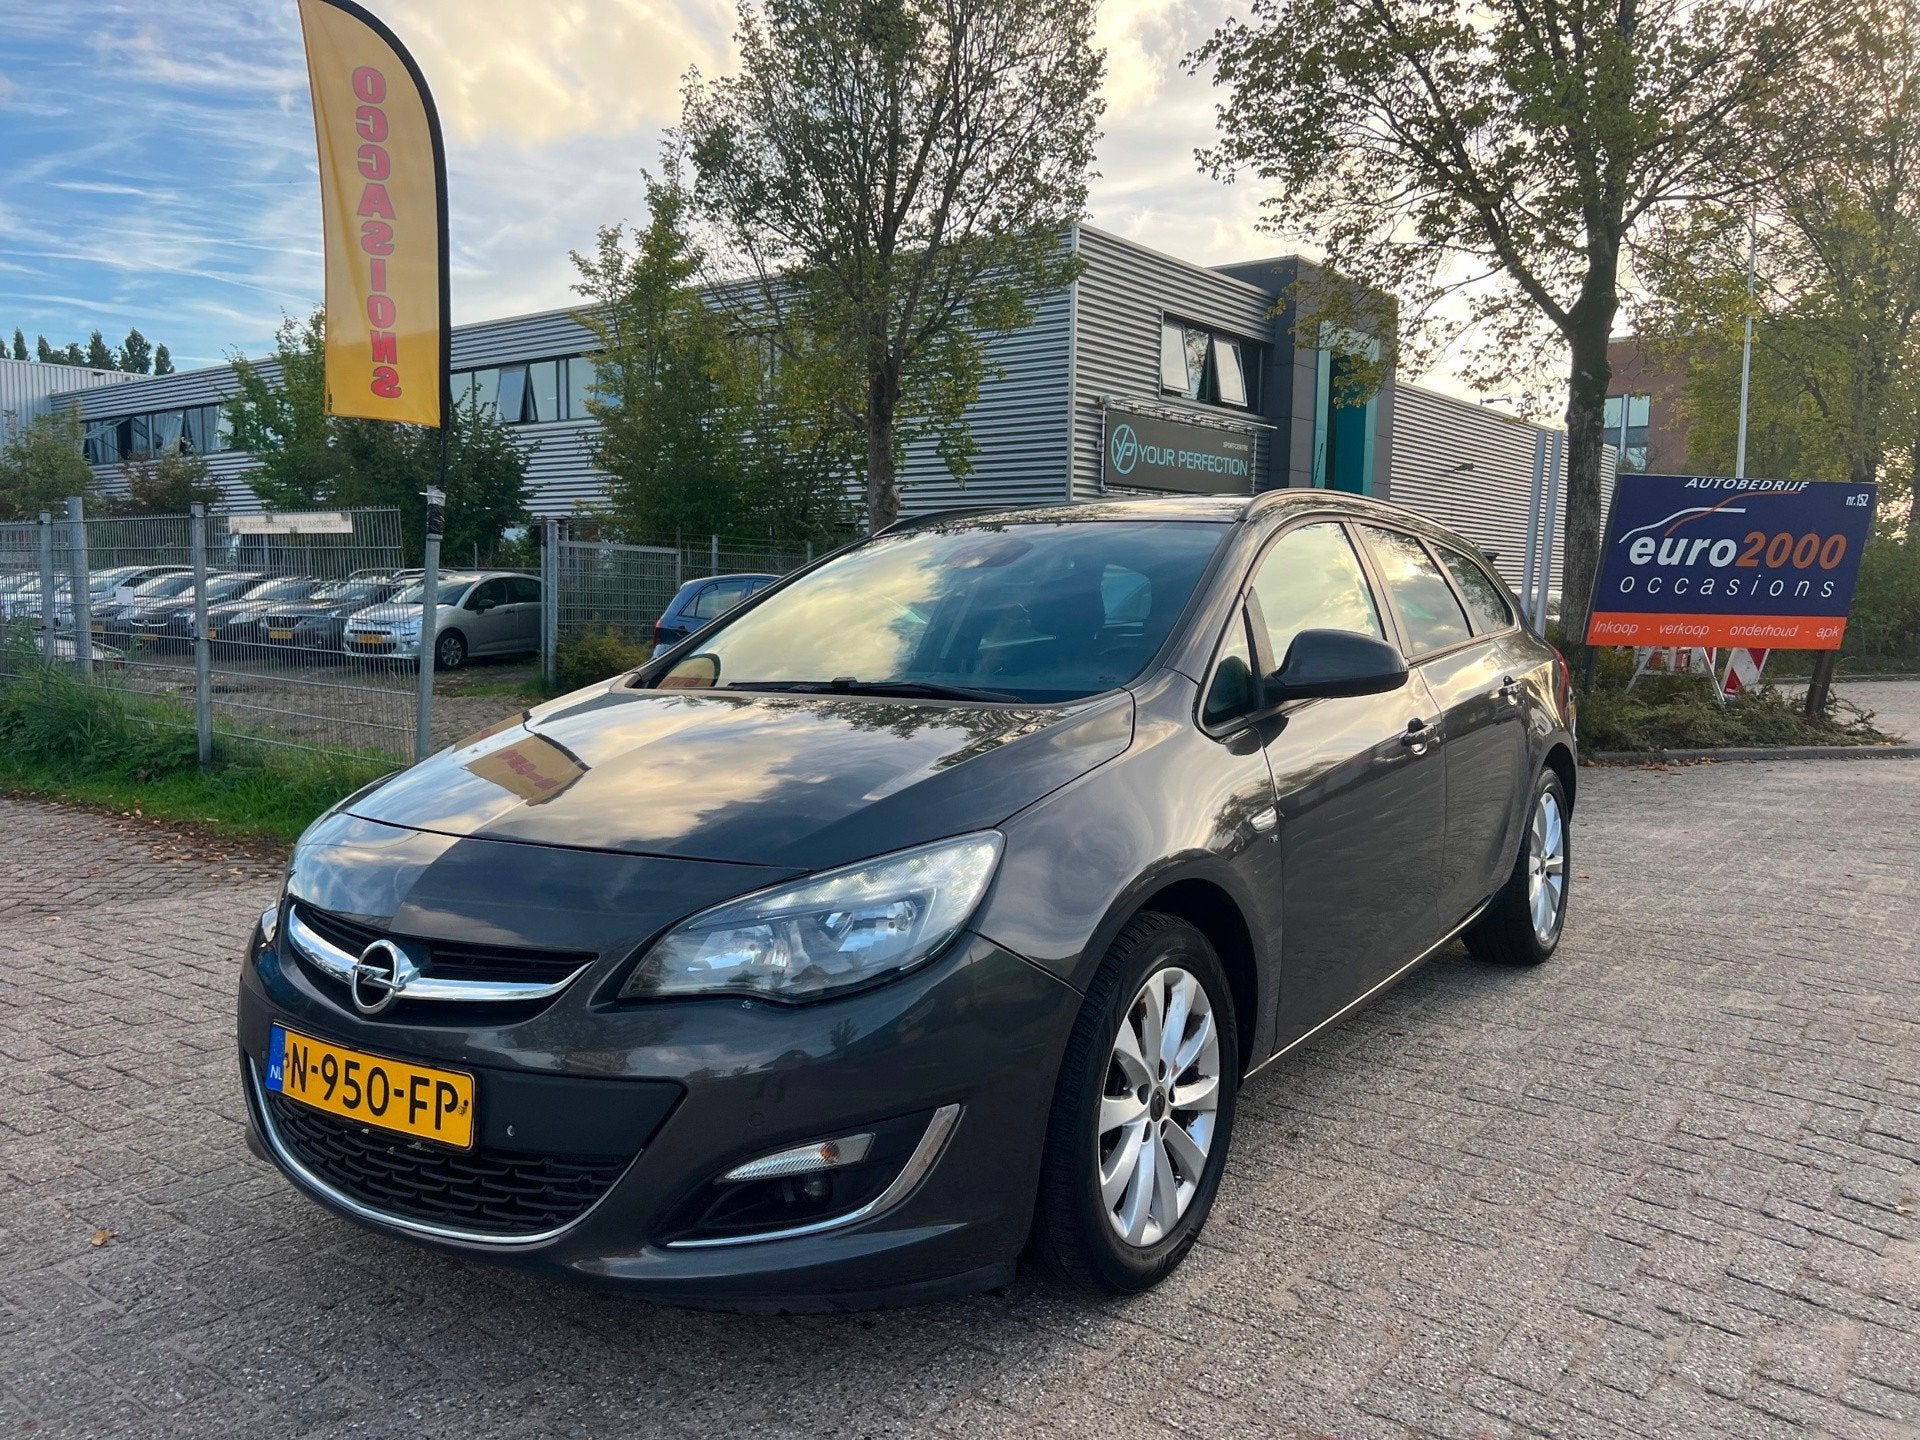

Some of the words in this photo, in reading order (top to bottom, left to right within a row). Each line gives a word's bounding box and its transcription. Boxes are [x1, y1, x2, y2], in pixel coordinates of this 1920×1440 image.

[1138, 444, 1175, 467] YOUR
[1178, 450, 1248, 476] PERFECTION
[1684, 477, 1810, 492] AUTOBEDRIJF
[1845, 494, 1869, 507] nr.152
[1628, 531, 1848, 570] euro2000
[1619, 574, 1835, 598] occasions
[1594, 620, 1639, 636] Inkoop
[1659, 623, 1710, 637] verkoop
[1729, 624, 1799, 638] onderhoud
[1816, 625, 1840, 640] apk
[270, 1064, 283, 1081] NL
[290, 1042, 459, 1130] N-950-FP
